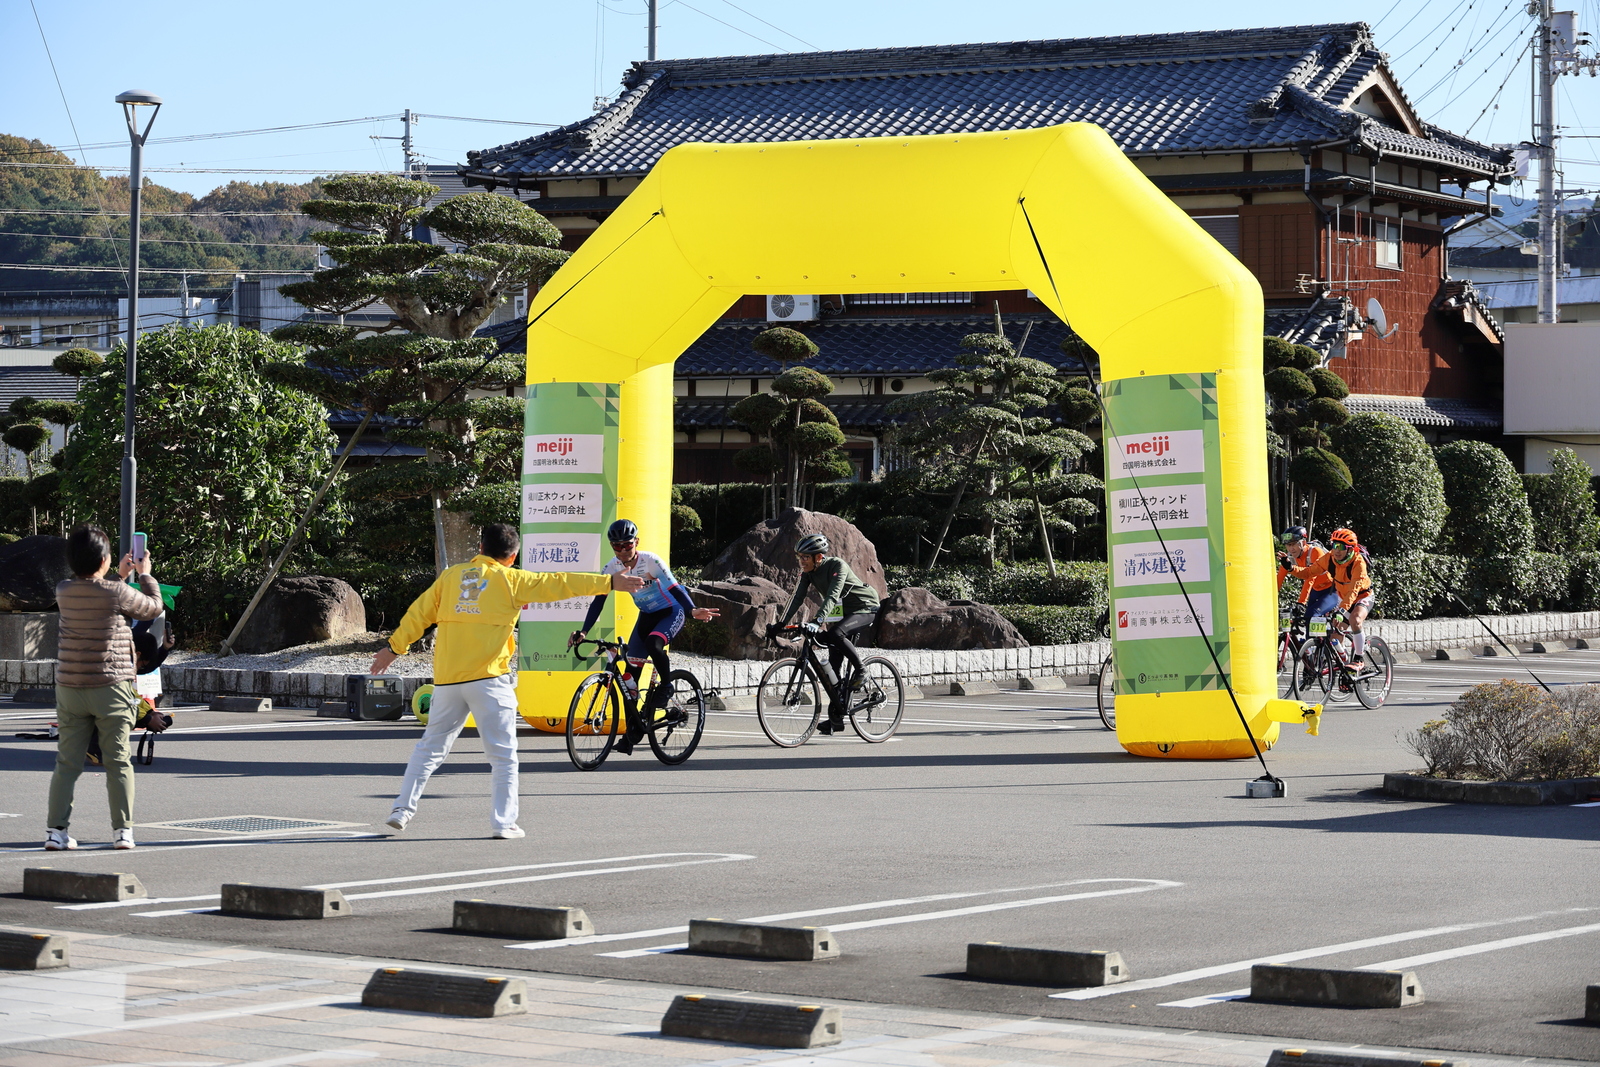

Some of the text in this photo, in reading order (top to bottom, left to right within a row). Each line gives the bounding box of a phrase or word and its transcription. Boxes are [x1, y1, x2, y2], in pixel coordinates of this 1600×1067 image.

[536, 437, 573, 456] meiji
[1126, 435, 1170, 456] meiji
[533, 458, 578, 467] 四国明治株式会社
[1122, 458, 1177, 470] 四国明治株式会社
[528, 504, 586, 515] ファーム合同会社
[1120, 508, 1189, 523] ファーム合同会社
[528, 547, 580, 563] 清水建設
[1124, 556, 1187, 576] 清水建設
[1130, 613, 1206, 627] 南商事株式会社
[1311, 623, 1325, 631] 017
